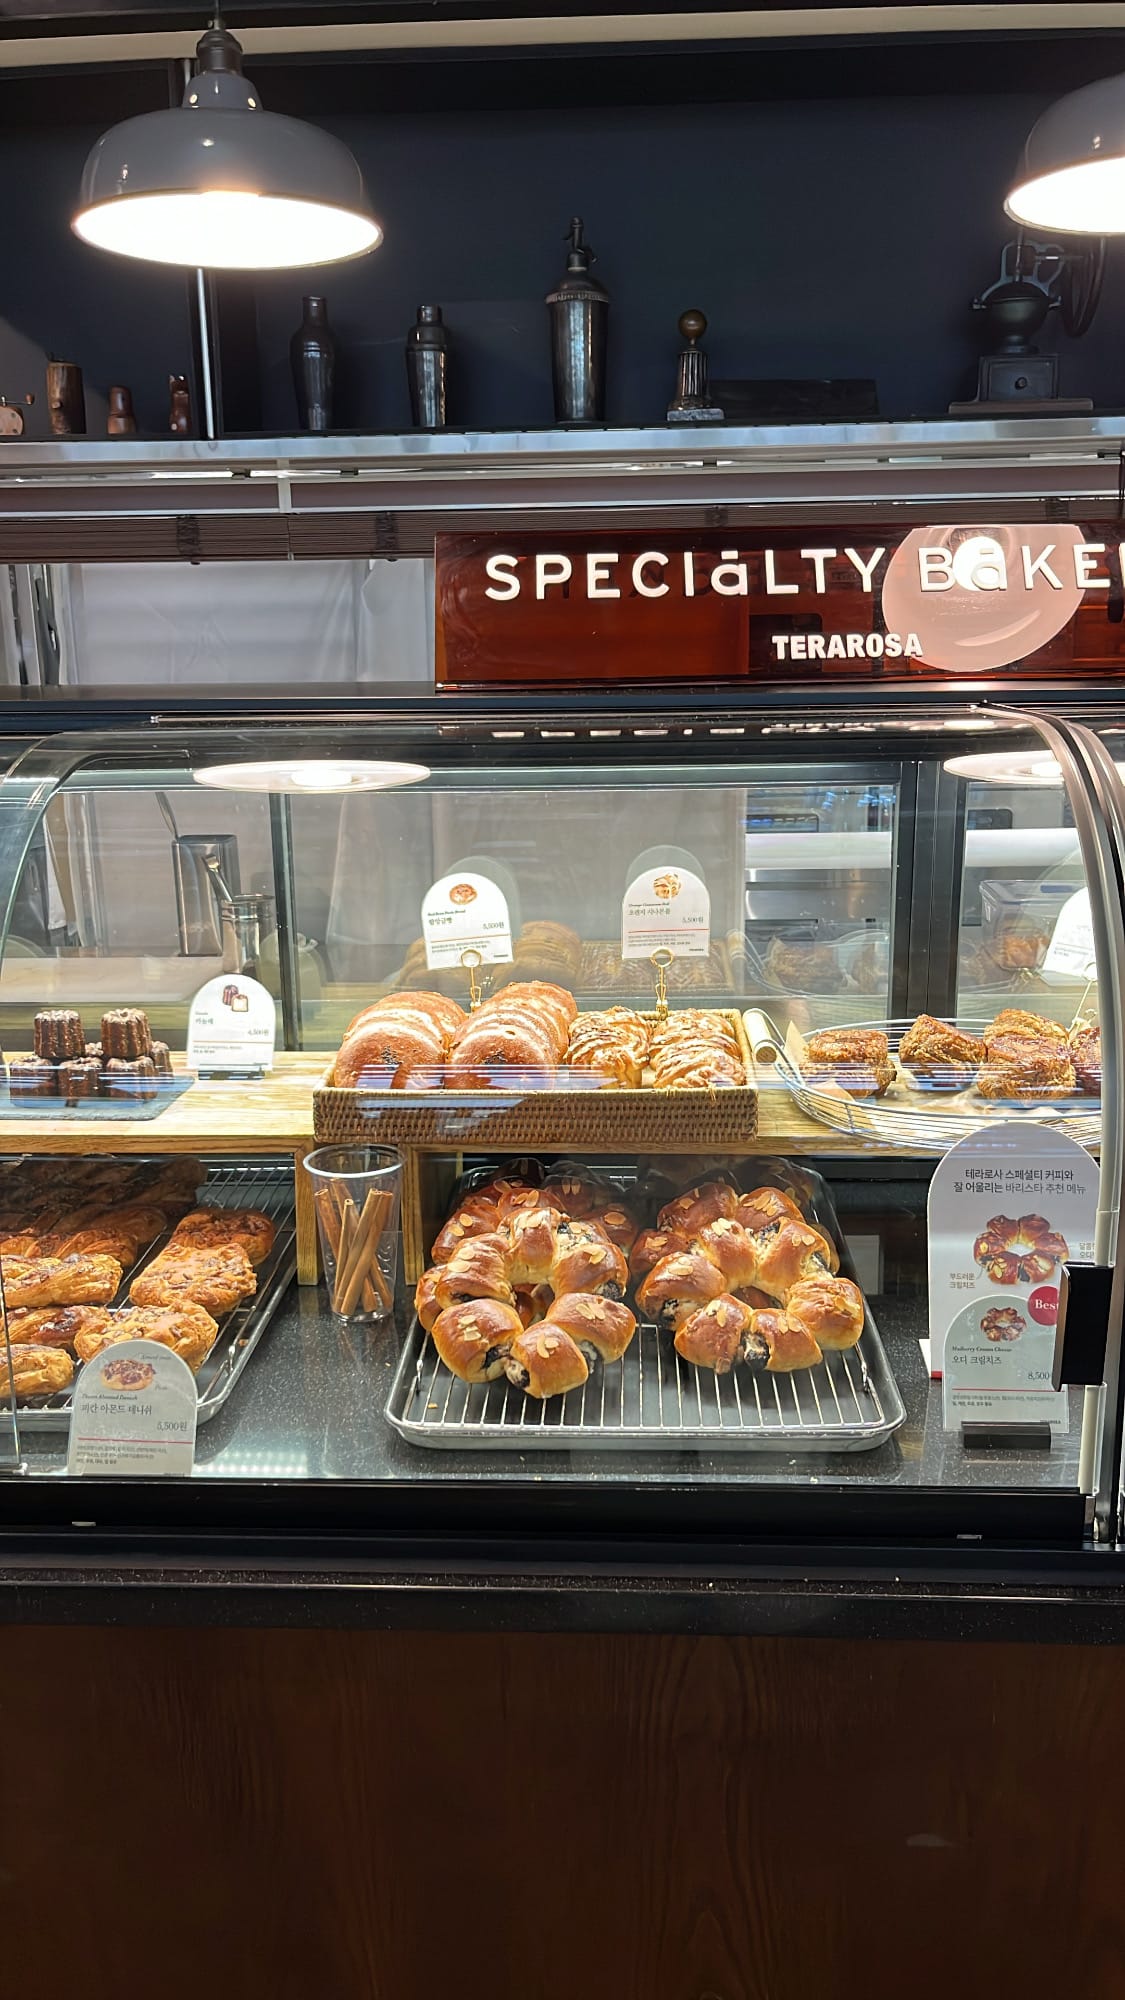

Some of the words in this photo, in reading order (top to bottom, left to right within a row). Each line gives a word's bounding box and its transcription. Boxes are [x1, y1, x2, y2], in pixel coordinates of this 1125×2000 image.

[771, 633, 924, 661] TERAROSA
[965, 1169, 1003, 1180] 테라로사
[1005, 1169, 1043, 1181] 스페셜티
[1045, 1169, 1074, 1181] 커피와
[953, 1182, 964, 1193] 잘
[965, 1182, 1003, 1193] 어울리는
[1005, 1183, 1044, 1195] 바리스타
[1046, 1183, 1065, 1195] 추천
[1066, 1183, 1086, 1195] 메뉴
[949, 1273, 976, 1281] 부드러운
[949, 1281, 976, 1290] 크림치즈
[952, 1355, 967, 1365] 오디
[970, 1355, 1002, 1365] 크림치즈
[80, 1403, 99, 1414] 피칸
[100, 1403, 126, 1415] 아몬드
[127, 1404, 153, 1416] 데니쉬
[157, 1421, 188, 1432] 5,500원
